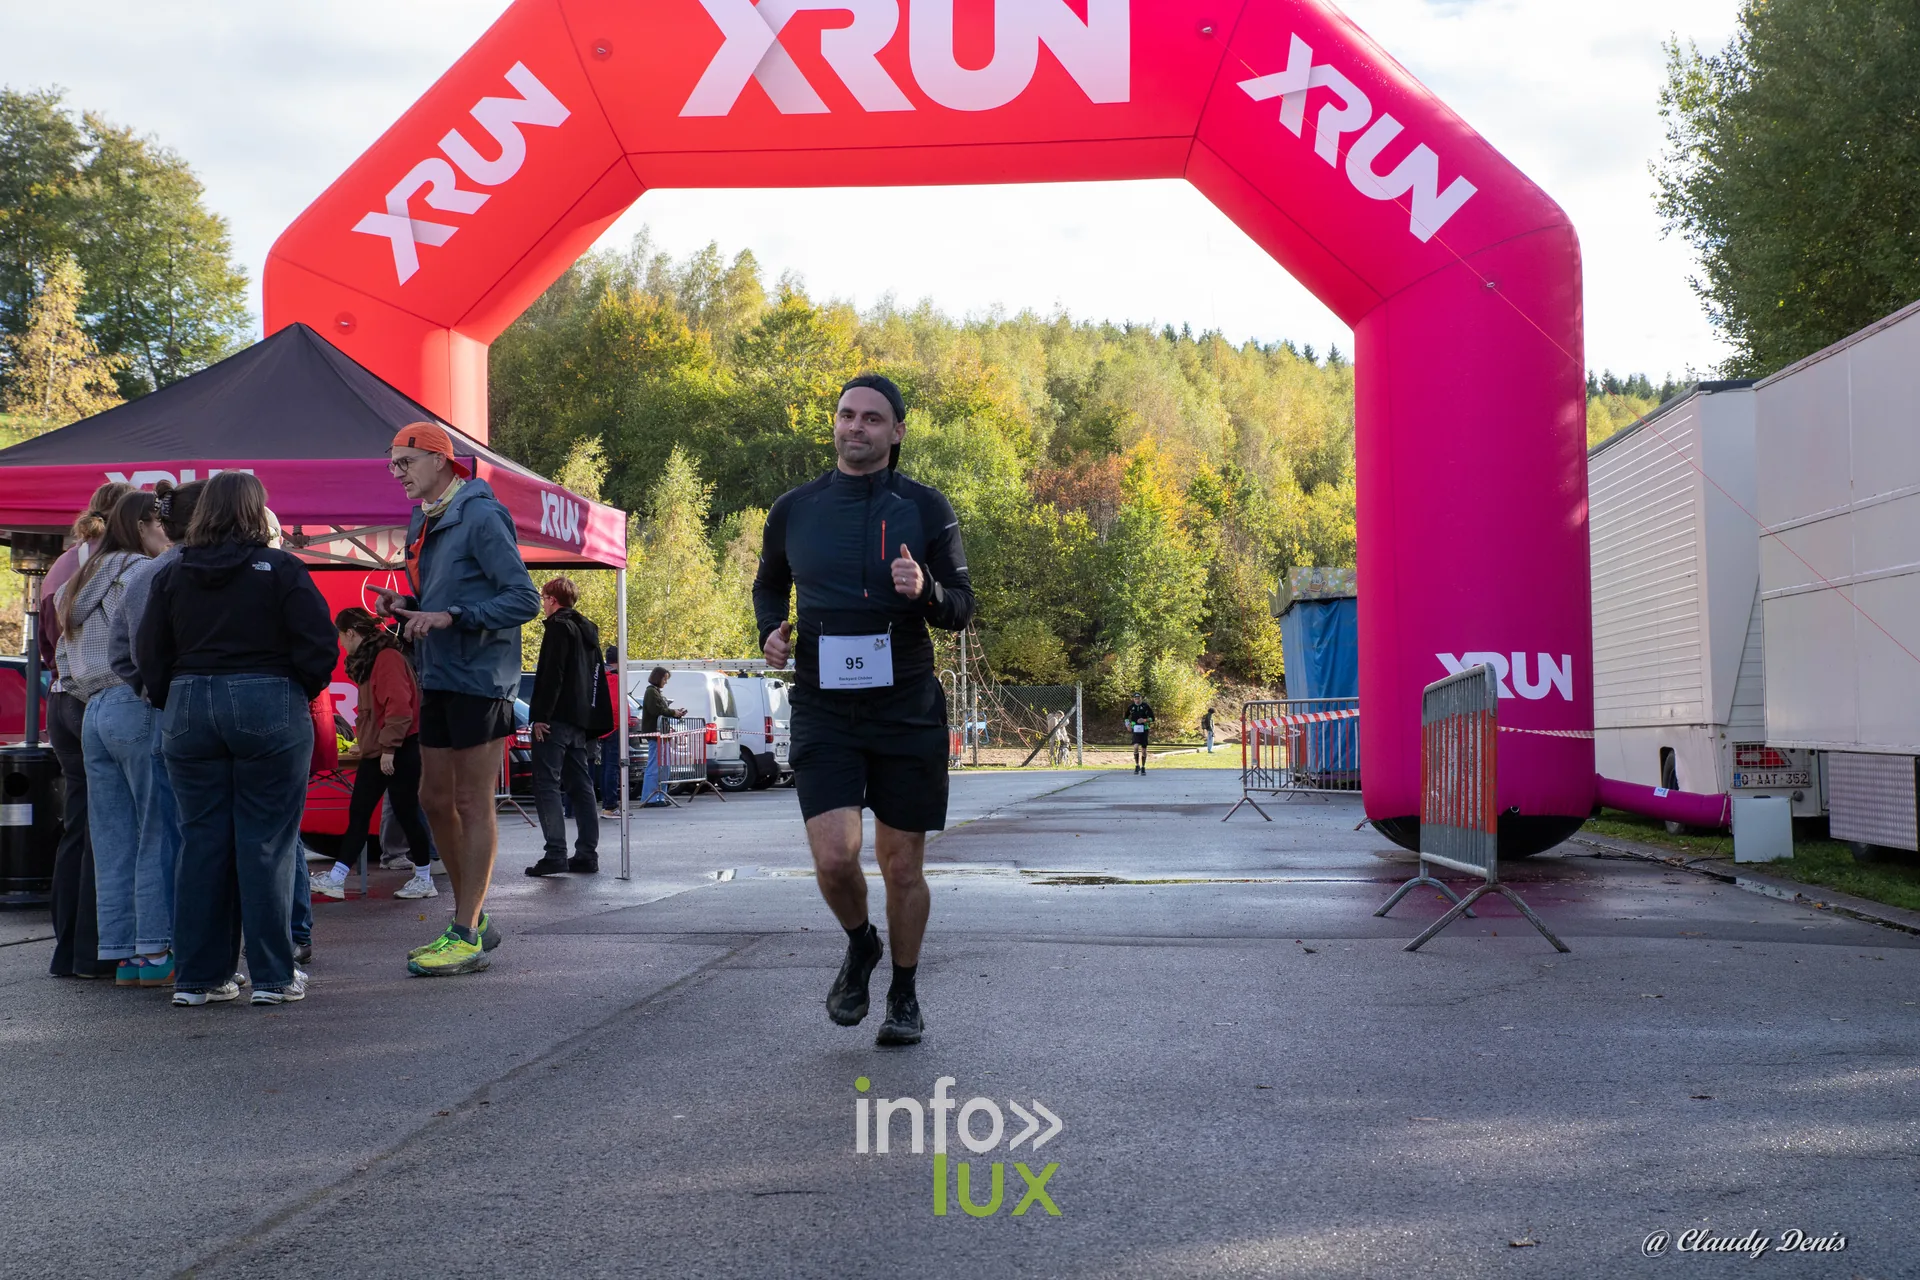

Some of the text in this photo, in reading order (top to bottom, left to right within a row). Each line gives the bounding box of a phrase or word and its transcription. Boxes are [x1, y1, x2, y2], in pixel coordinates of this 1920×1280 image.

[678, 0, 1131, 118] XRUN
[351, 61, 572, 286] XRUN
[1236, 32, 1479, 244] XRUN
[541, 490, 580, 545] XRUN
[845, 657, 864, 669] 95
